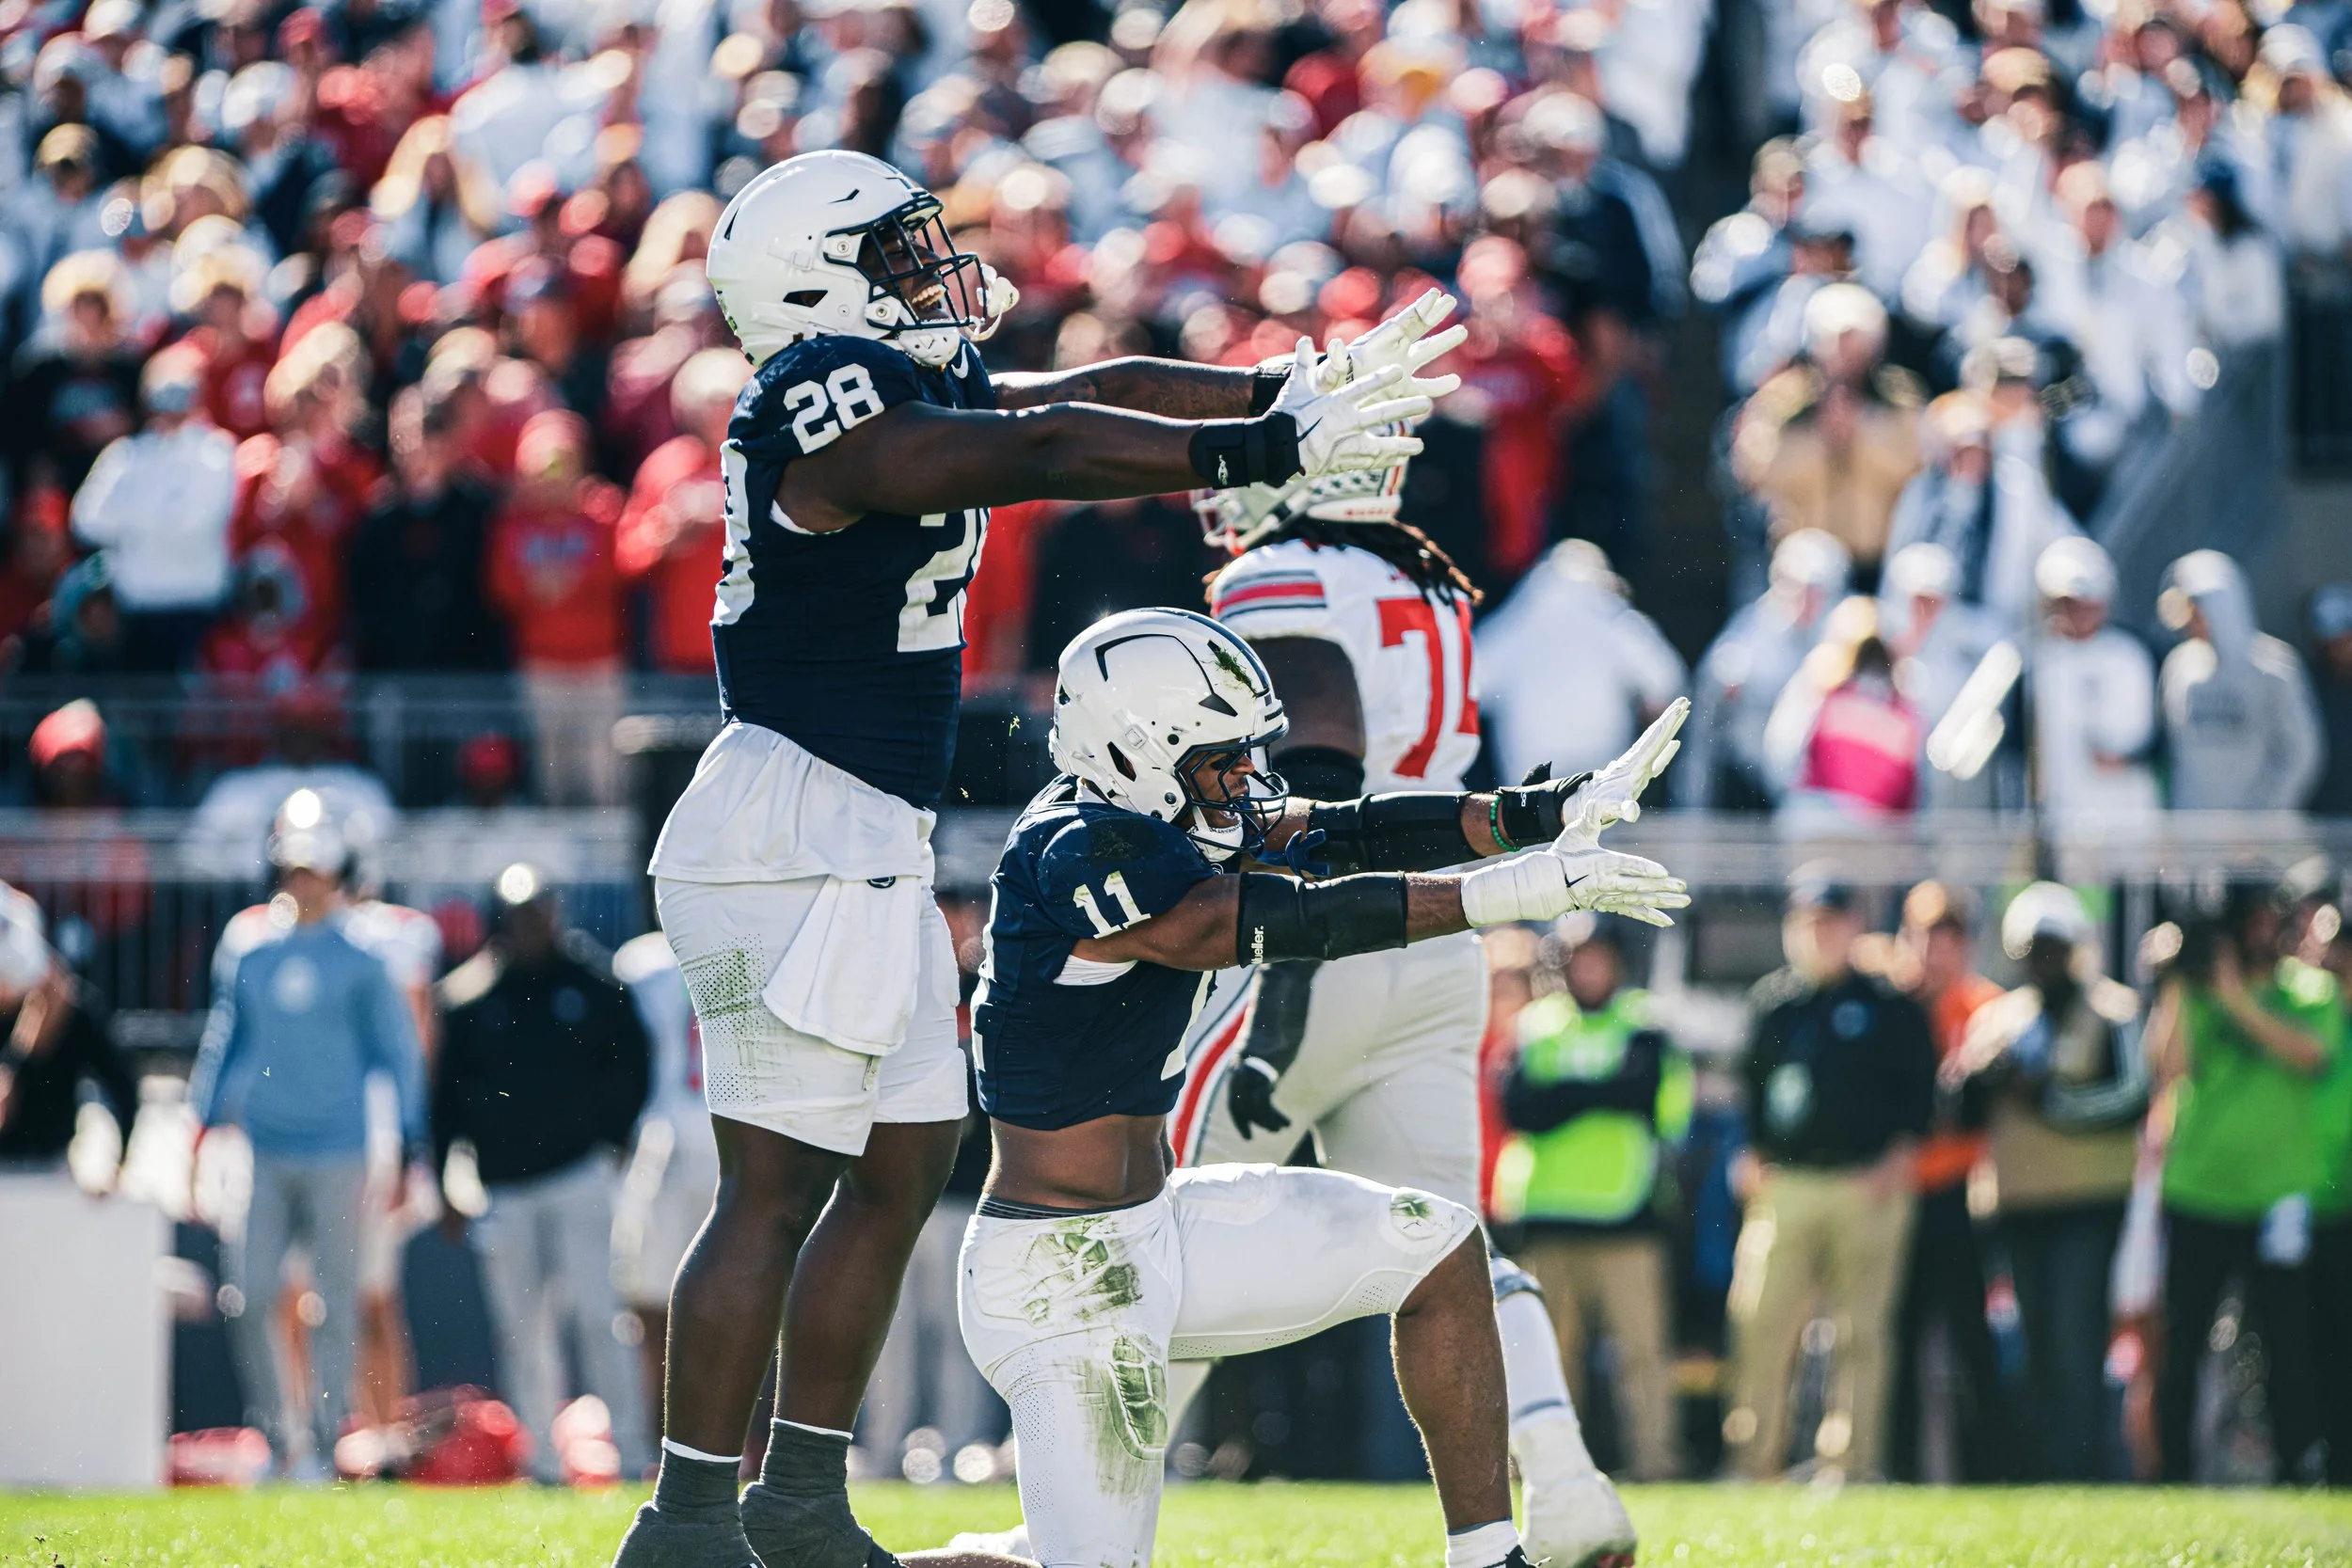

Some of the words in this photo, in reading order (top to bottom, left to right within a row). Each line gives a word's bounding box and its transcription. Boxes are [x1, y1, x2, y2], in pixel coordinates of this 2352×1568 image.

[783, 363, 884, 454] 28
[898, 508, 991, 653] 2
[1073, 870, 1151, 939] 11
